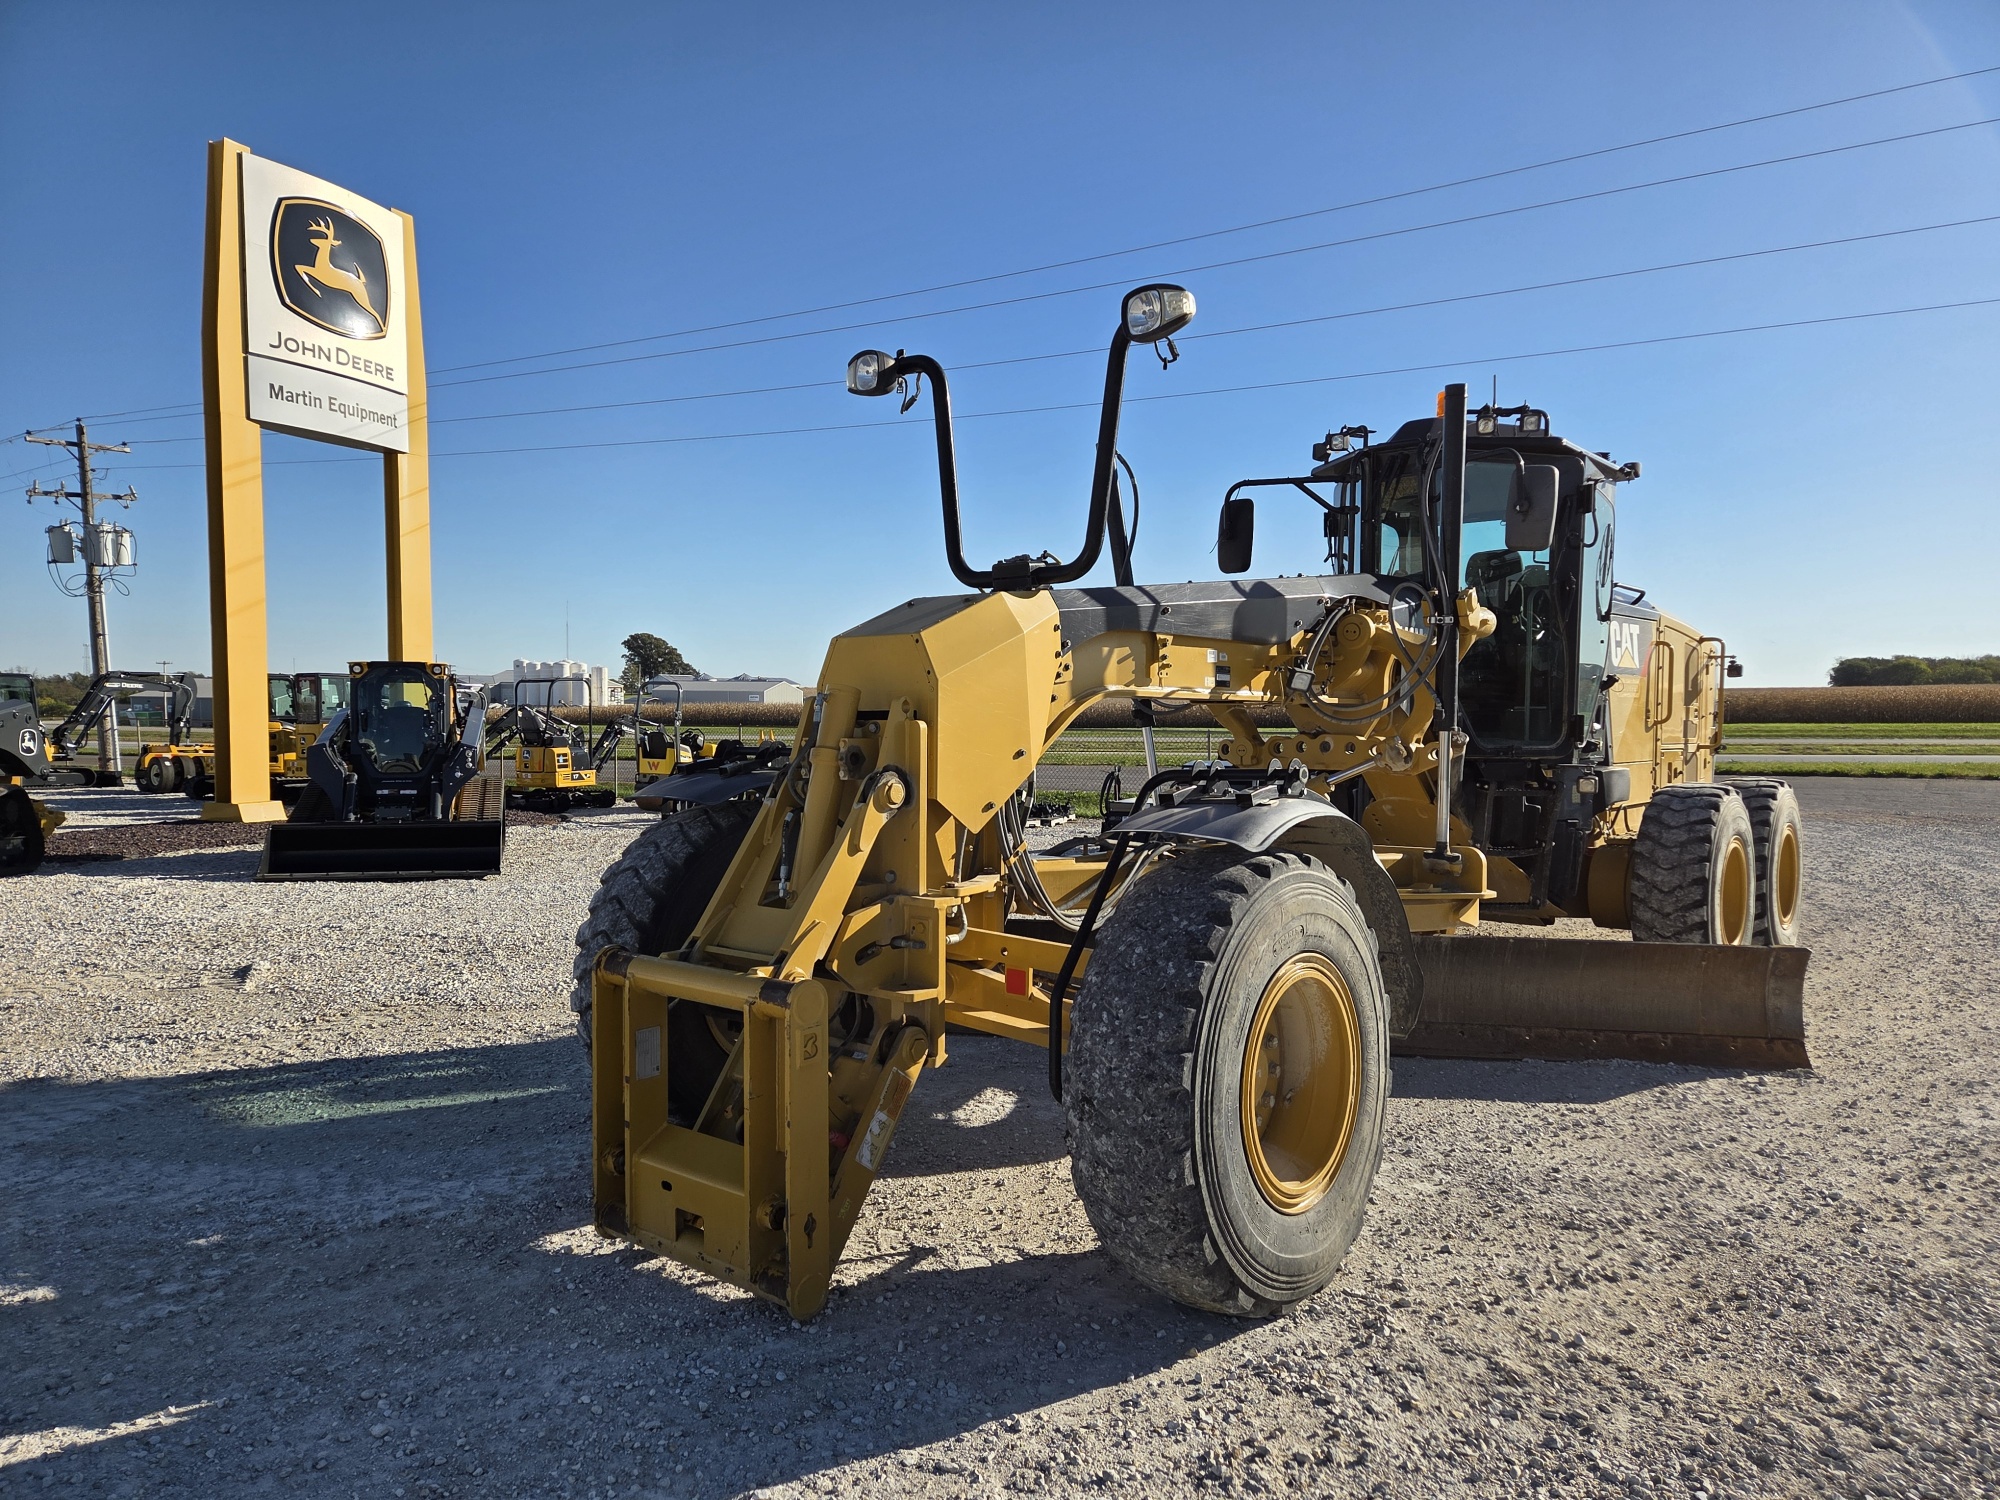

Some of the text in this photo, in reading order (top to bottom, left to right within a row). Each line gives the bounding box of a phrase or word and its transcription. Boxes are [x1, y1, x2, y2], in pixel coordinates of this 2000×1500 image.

[269, 331, 394, 381] JOHN DEERE
[269, 383, 398, 429] Martin Equipment
[1610, 620, 1640, 669] CAT
